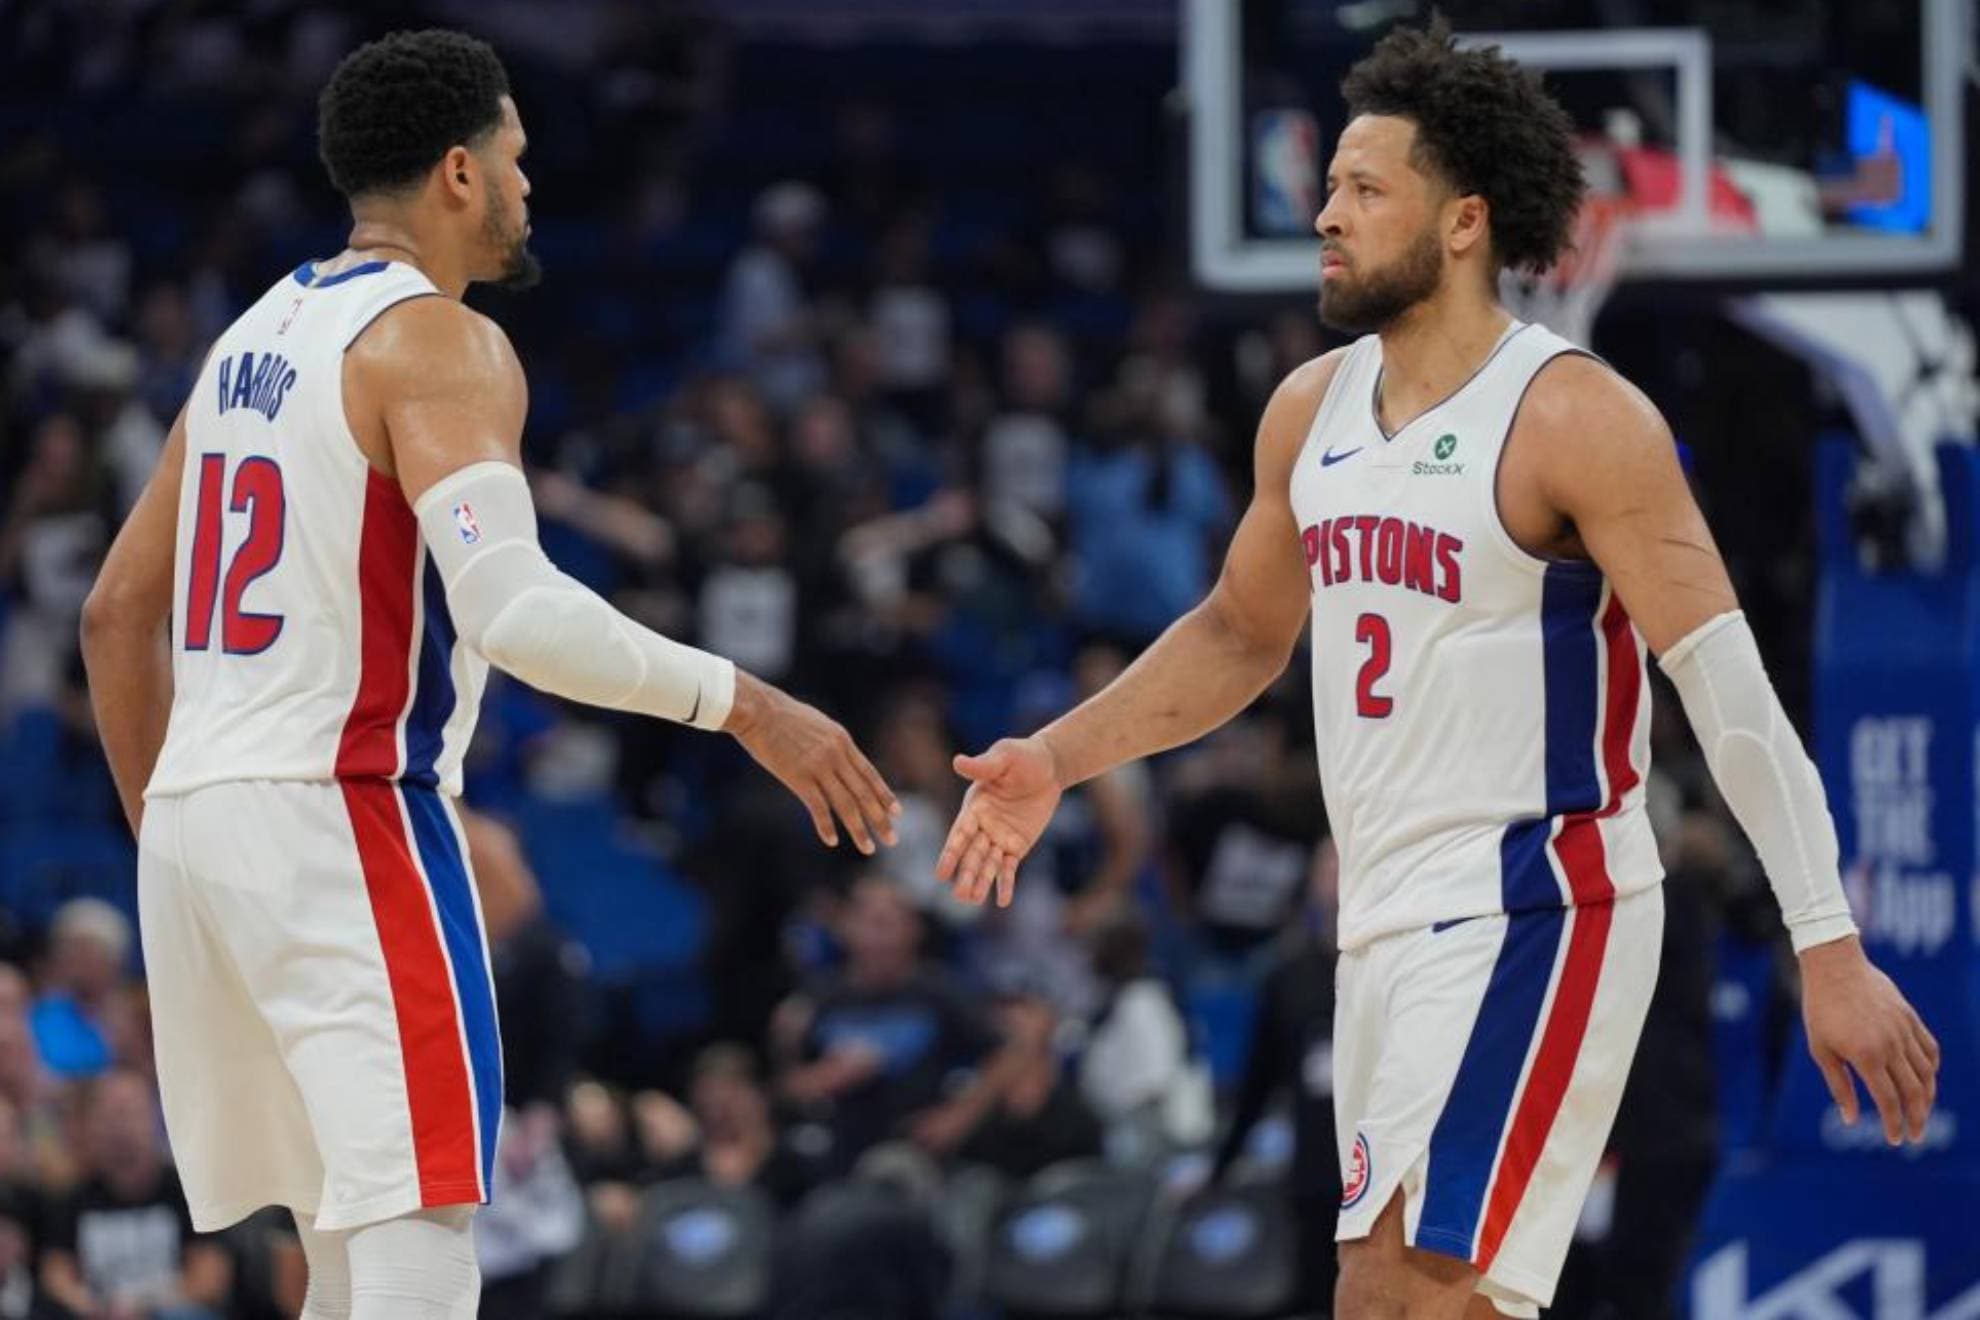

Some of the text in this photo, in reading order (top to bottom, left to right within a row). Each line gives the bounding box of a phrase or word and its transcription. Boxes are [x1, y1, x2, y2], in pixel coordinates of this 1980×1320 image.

[218, 352, 296, 422] HARRIS
[1412, 460, 1465, 475] StockX
[185, 452, 286, 655] 12
[1302, 515, 1463, 603] PISTONS
[1355, 612, 1393, 718] 2
